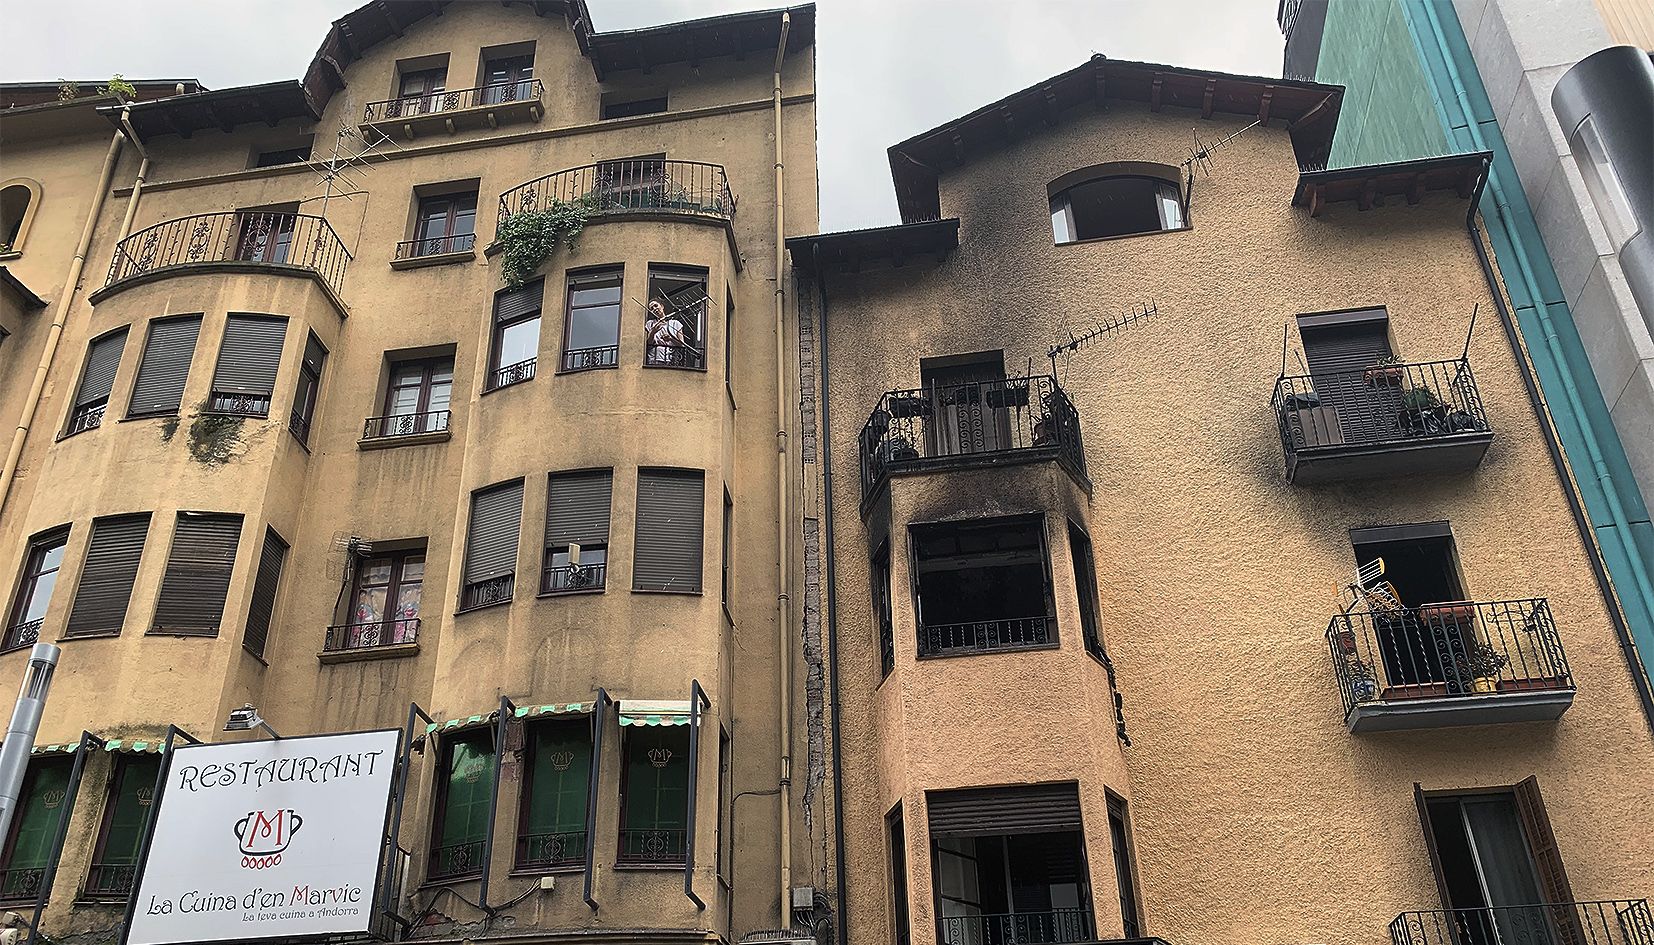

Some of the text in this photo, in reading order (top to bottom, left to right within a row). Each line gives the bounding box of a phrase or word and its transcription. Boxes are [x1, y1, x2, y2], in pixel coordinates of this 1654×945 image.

[179, 750, 383, 792] RESTAURANT
[246, 809, 284, 848] M
[146, 883, 362, 915] La Cuina d'en Marvic
[241, 911, 255, 922] La
[279, 909, 306, 919] cuina
[308, 909, 315, 918] a
[317, 906, 359, 918] Andorra
